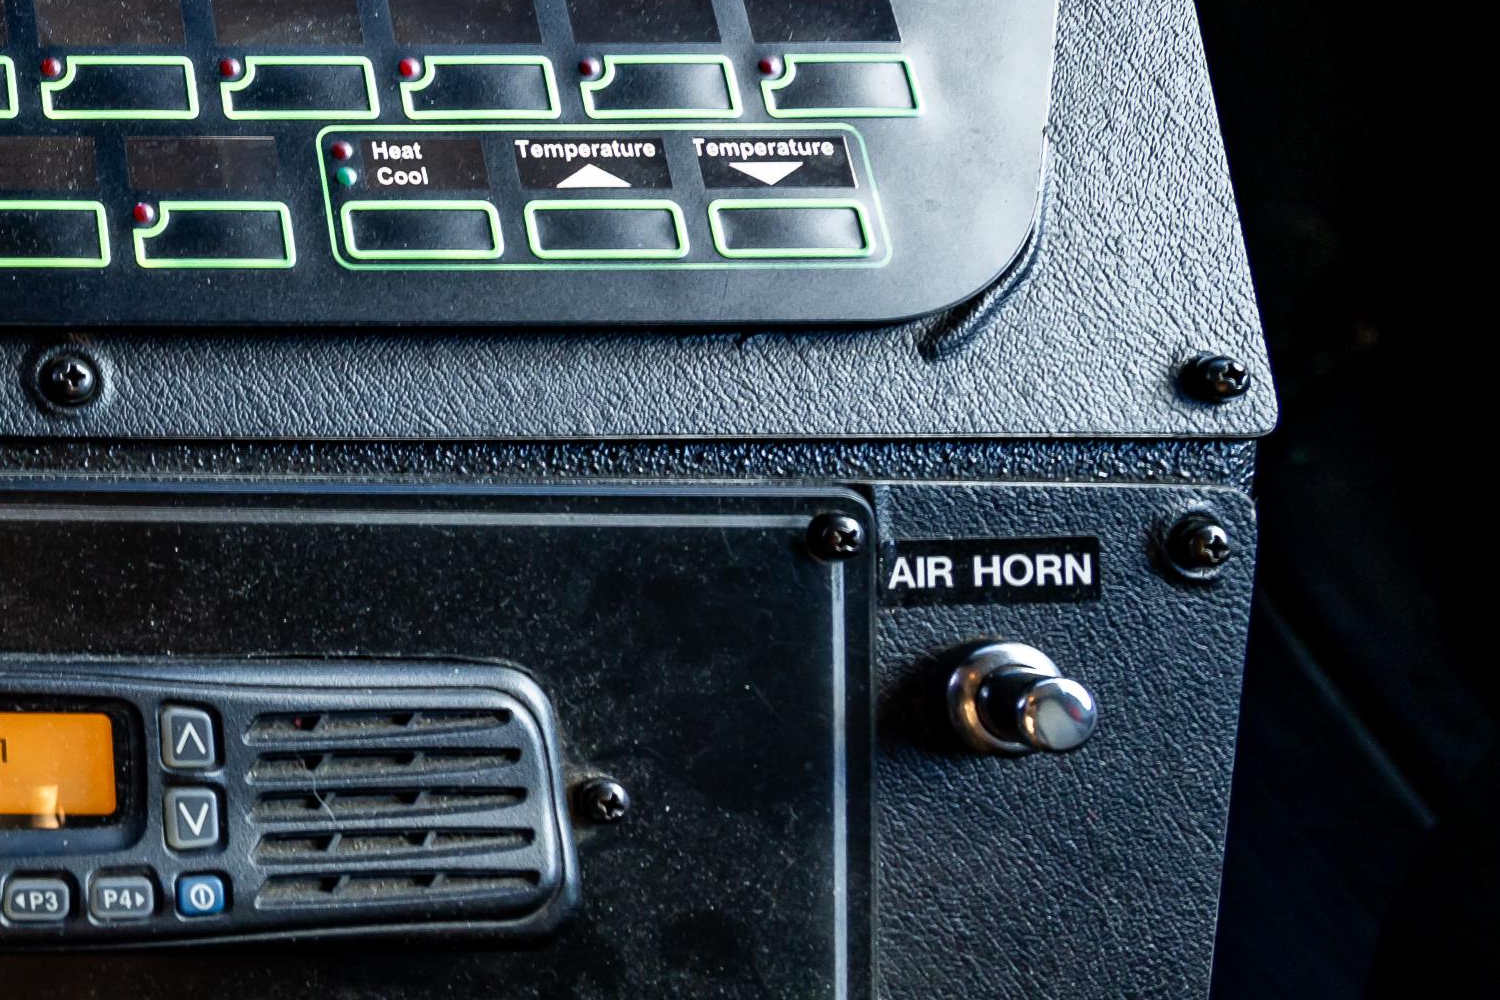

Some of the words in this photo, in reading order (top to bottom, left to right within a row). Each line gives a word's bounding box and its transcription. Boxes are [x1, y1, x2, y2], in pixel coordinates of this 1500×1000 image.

[371, 140, 423, 161] Heat
[514, 139, 656, 162] Temperature
[692, 136, 835, 161] Temperature
[376, 166, 430, 186] Cool
[888, 555, 954, 590] AIR
[973, 553, 1093, 587] HORN
[29, 891, 60, 913] P3
[103, 889, 132, 911] P4
